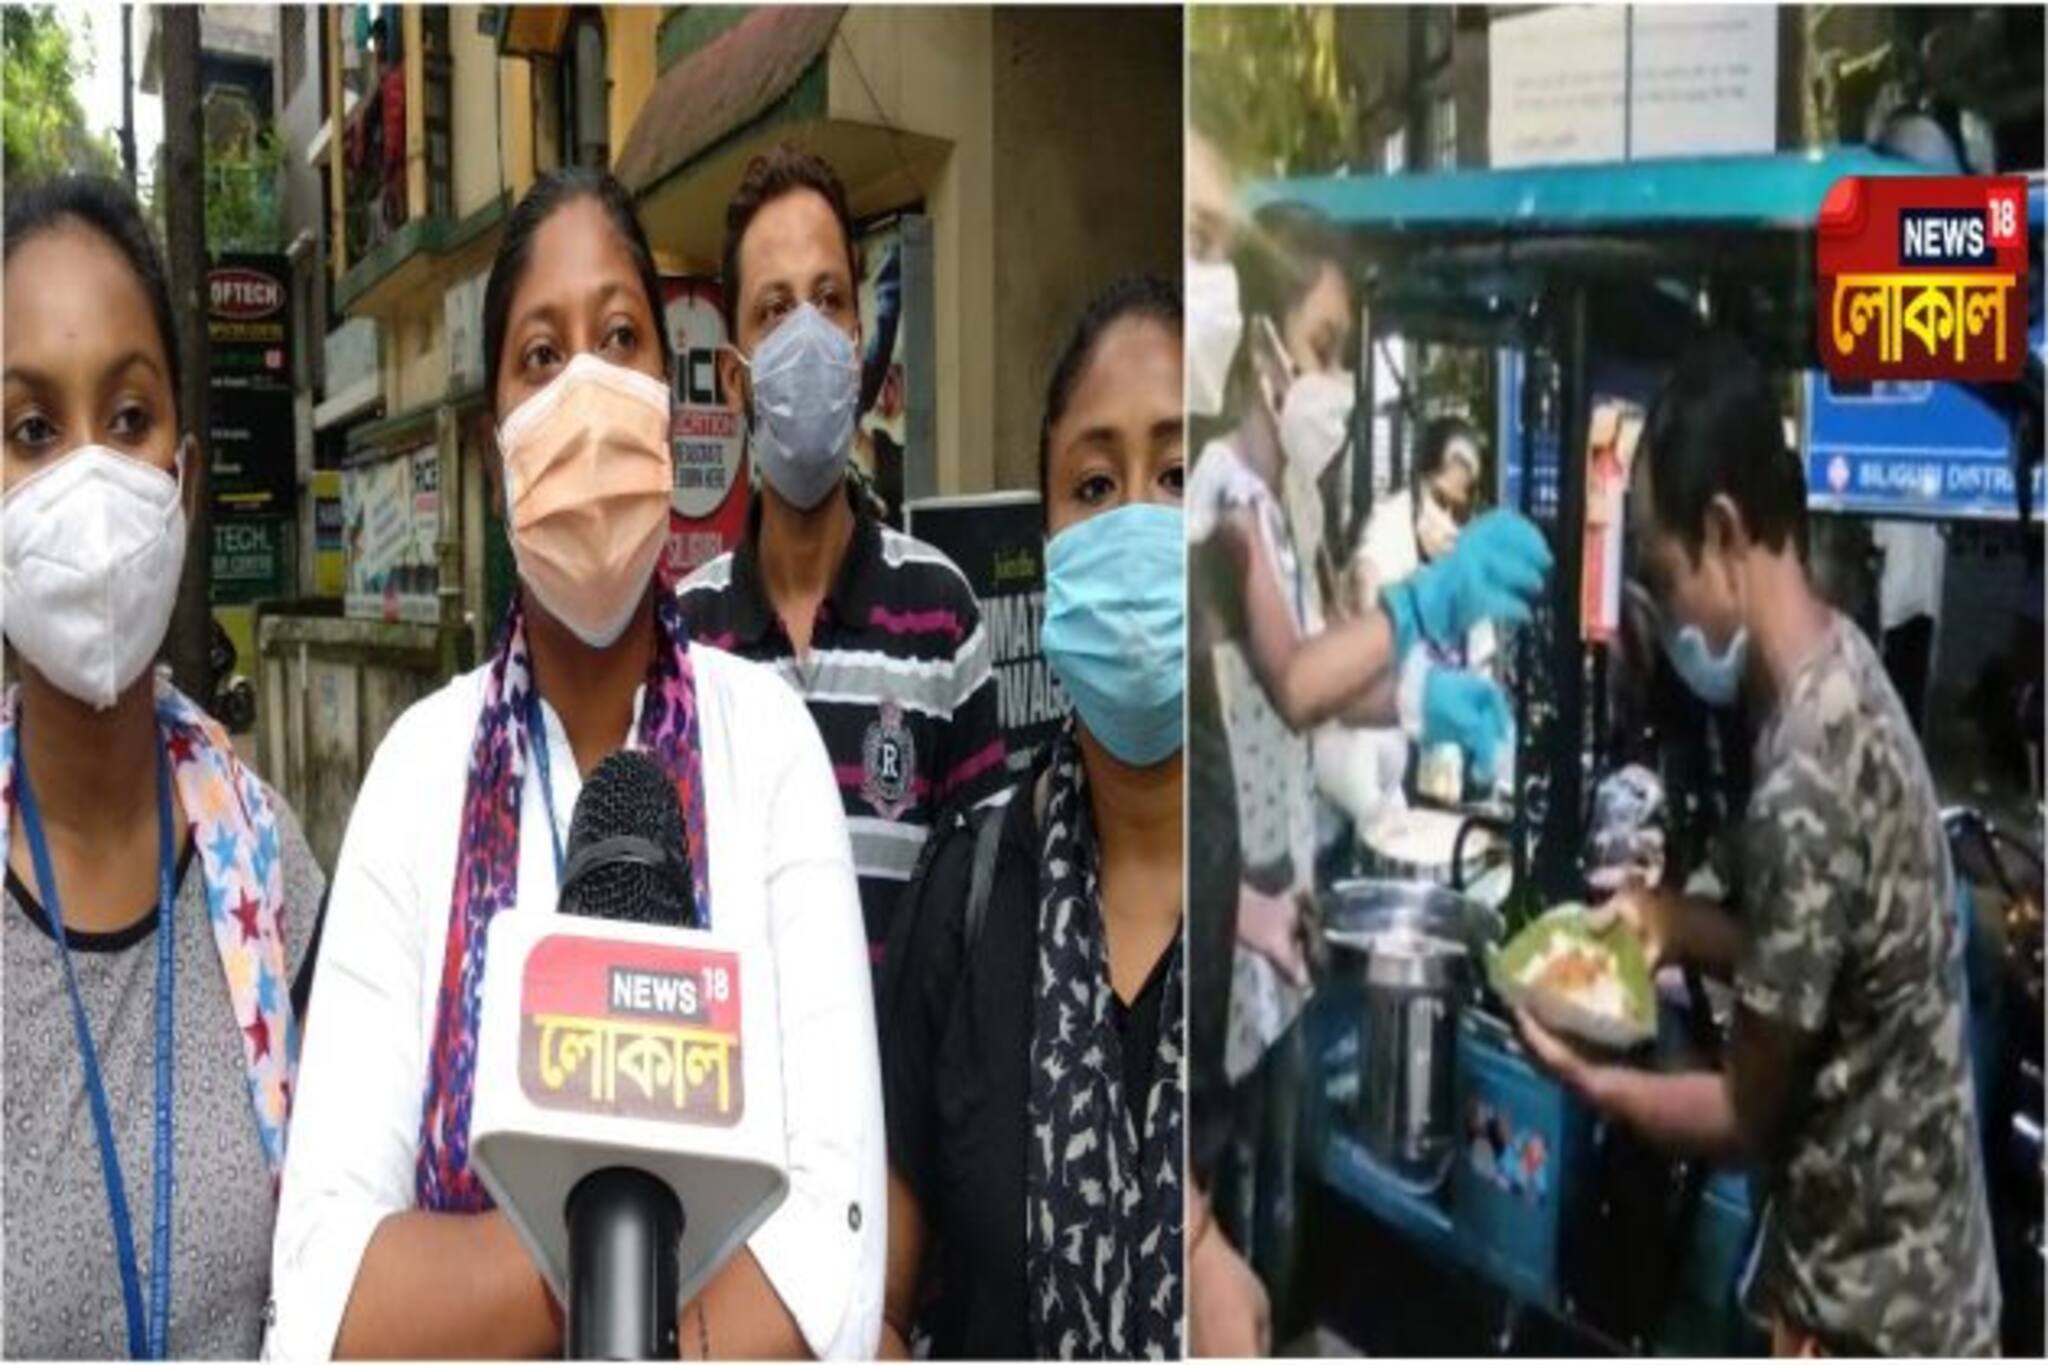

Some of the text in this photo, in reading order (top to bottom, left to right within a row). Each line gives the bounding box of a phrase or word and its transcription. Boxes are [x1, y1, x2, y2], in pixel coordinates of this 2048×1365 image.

[209, 279, 279, 306] OFTECH
[882, 742, 899, 779] R
[612, 966, 730, 1015] NEWS 18
[532, 1013, 738, 1114] লোকাল
